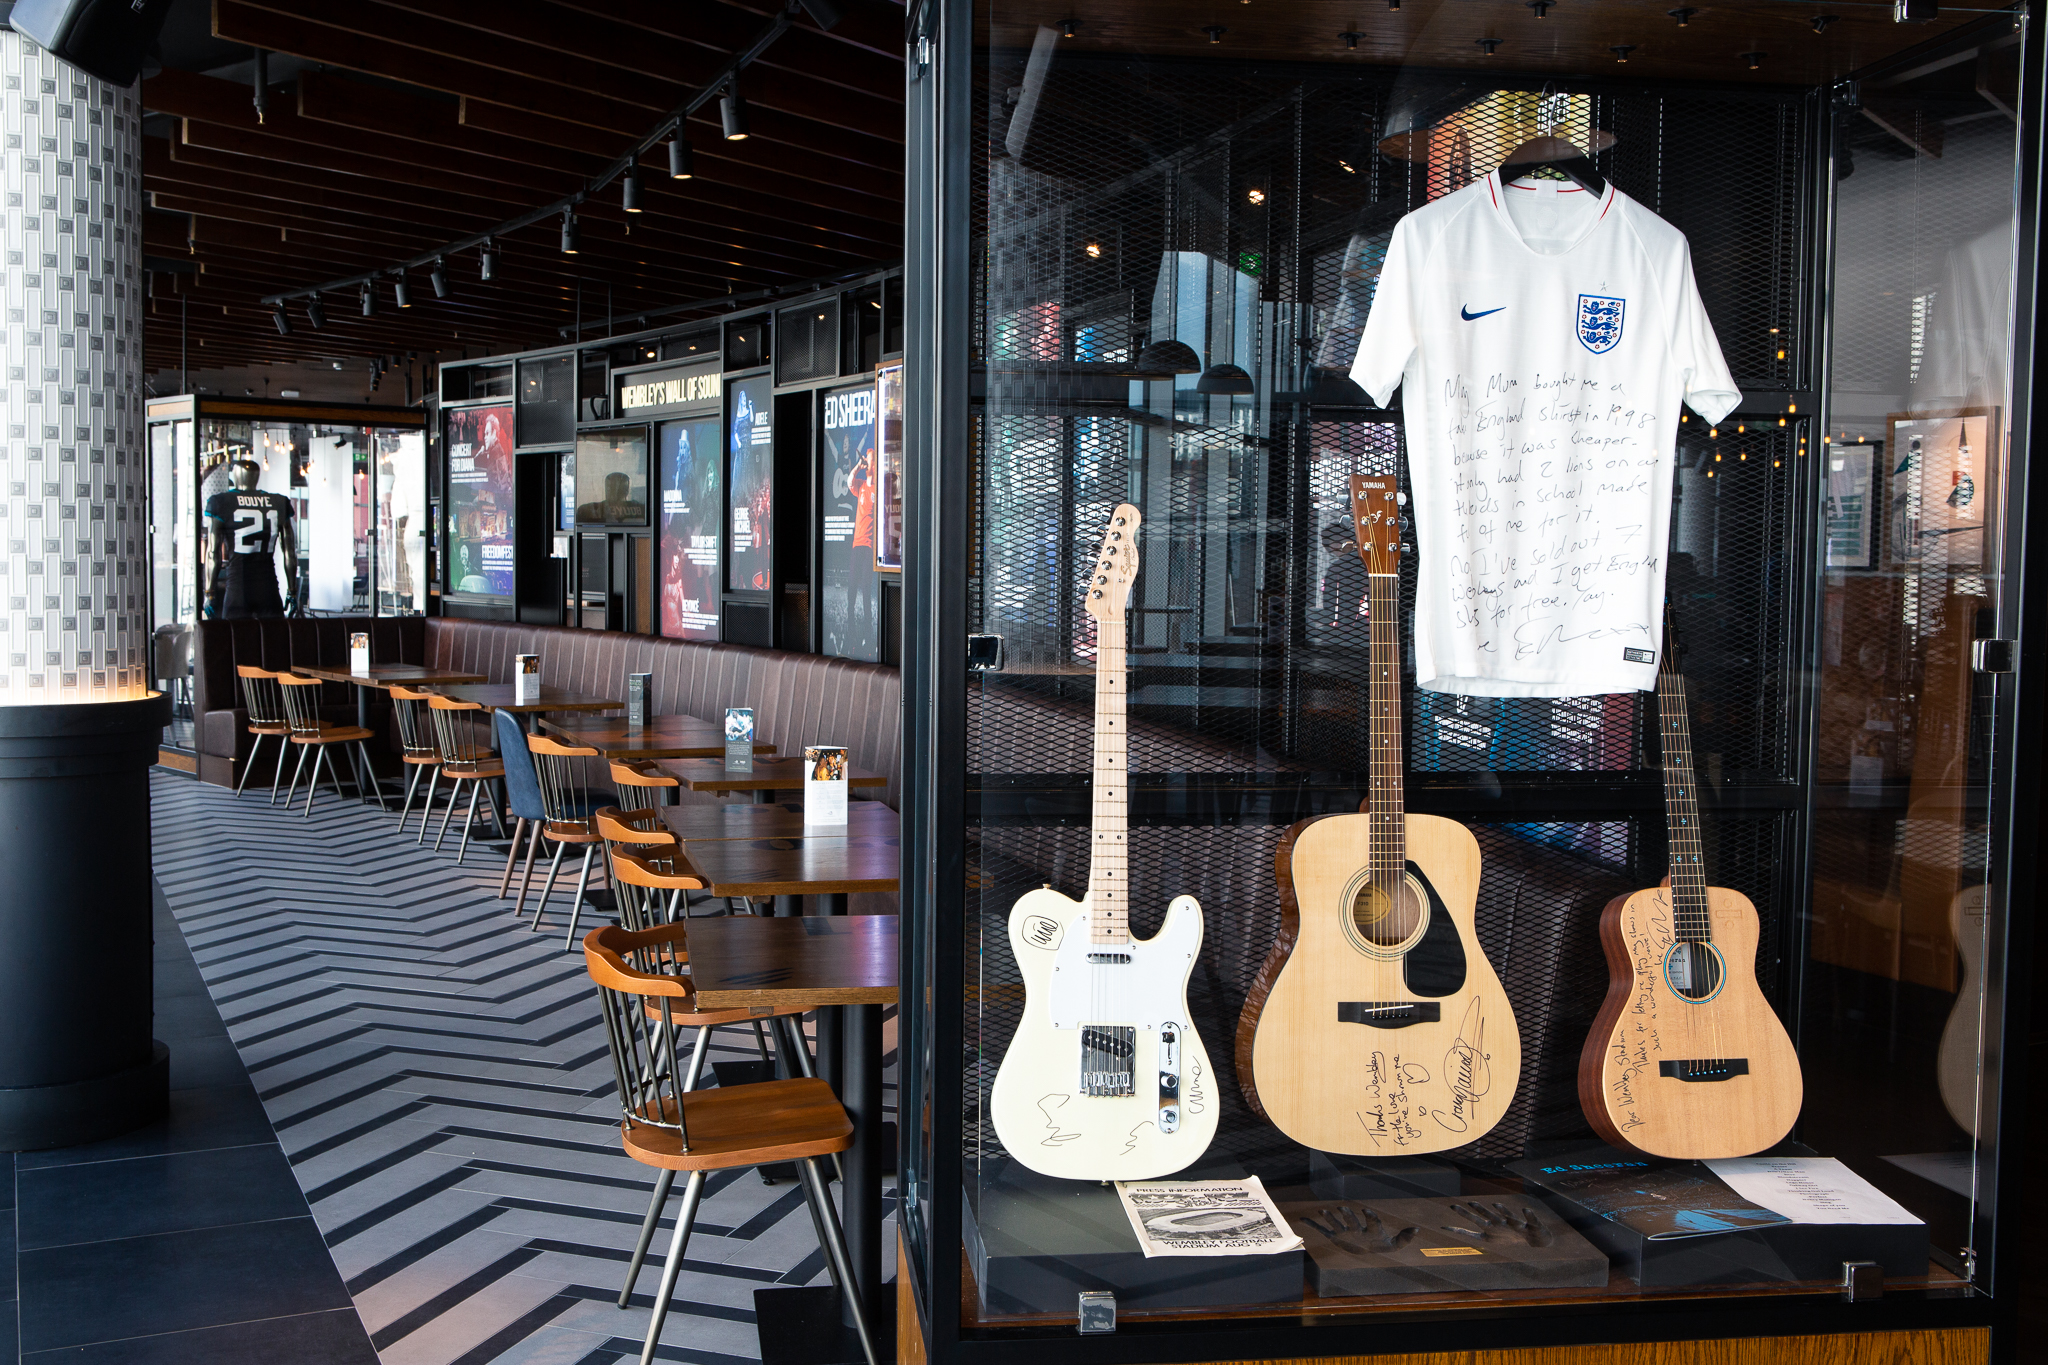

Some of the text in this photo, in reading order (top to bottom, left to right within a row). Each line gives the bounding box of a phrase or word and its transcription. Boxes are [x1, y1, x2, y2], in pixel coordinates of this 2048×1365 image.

[621, 381, 666, 409] WEMBLEY'S
[665, 378, 686, 404] WALL
[687, 376, 698, 402] OF
[1487, 372, 1518, 398] Mum
[1533, 371, 1576, 402] bought
[1580, 379, 1600, 391] me
[1610, 383, 1626, 396] a
[755, 411, 768, 426] ADELE
[824, 395, 839, 430] ED
[1475, 397, 1526, 441] England
[1584, 404, 1599, 423] in
[1606, 403, 1656, 429] 1998
[451, 443, 472, 458] CONCERT
[1499, 438, 1515, 460] it
[1521, 439, 1557, 455] was
[451, 457, 475, 472] FOR DIANA
[1497, 459, 1525, 484] had
[1540, 460, 1554, 478] 2
[1566, 454, 1594, 474] lions
[1605, 458, 1629, 469] on
[1361, 481, 1386, 490] YAMAHA
[1511, 489, 1526, 511] in
[1536, 479, 1583, 503] school
[1597, 474, 1649, 496] made
[236, 495, 273, 508] BOUYE
[733, 507, 750, 520] GEORGE
[233, 508, 279, 554] 21
[1478, 519, 1498, 545] of
[1506, 520, 1531, 533] me
[1538, 511, 1569, 538] for
[481, 545, 514, 559] FREEDOMFEST
[705, 535, 718, 549] SWIFT
[1530, 534, 1567, 566] sold
[1570, 529, 1602, 553] out
[1513, 569, 1539, 589] and
[1551, 561, 1570, 587] I
[1570, 555, 1604, 593] get
[1490, 603, 1515, 628] for
[1629, 904, 1635, 913] in
[1629, 917, 1639, 940] shows
[1635, 957, 1649, 977] play
[1639, 981, 1645, 991] me
[1644, 964, 1658, 1010] wonderful
[1636, 1022, 1648, 1034] for
[1652, 1029, 1663, 1052] such
[1393, 1054, 1400, 1070] me
[1632, 1040, 1651, 1074] Thanks
[1612, 1029, 1646, 1133] Dear Wembley Stadium
[1356, 1051, 1388, 1148] Thanks Wembley
[1388, 1092, 1399, 1115] love
[1389, 1116, 1403, 1133] the
[1402, 1106, 1421, 1139] you've
[1540, 1165, 1568, 1175] Ed
[1569, 1161, 1649, 1171] Sheeran
